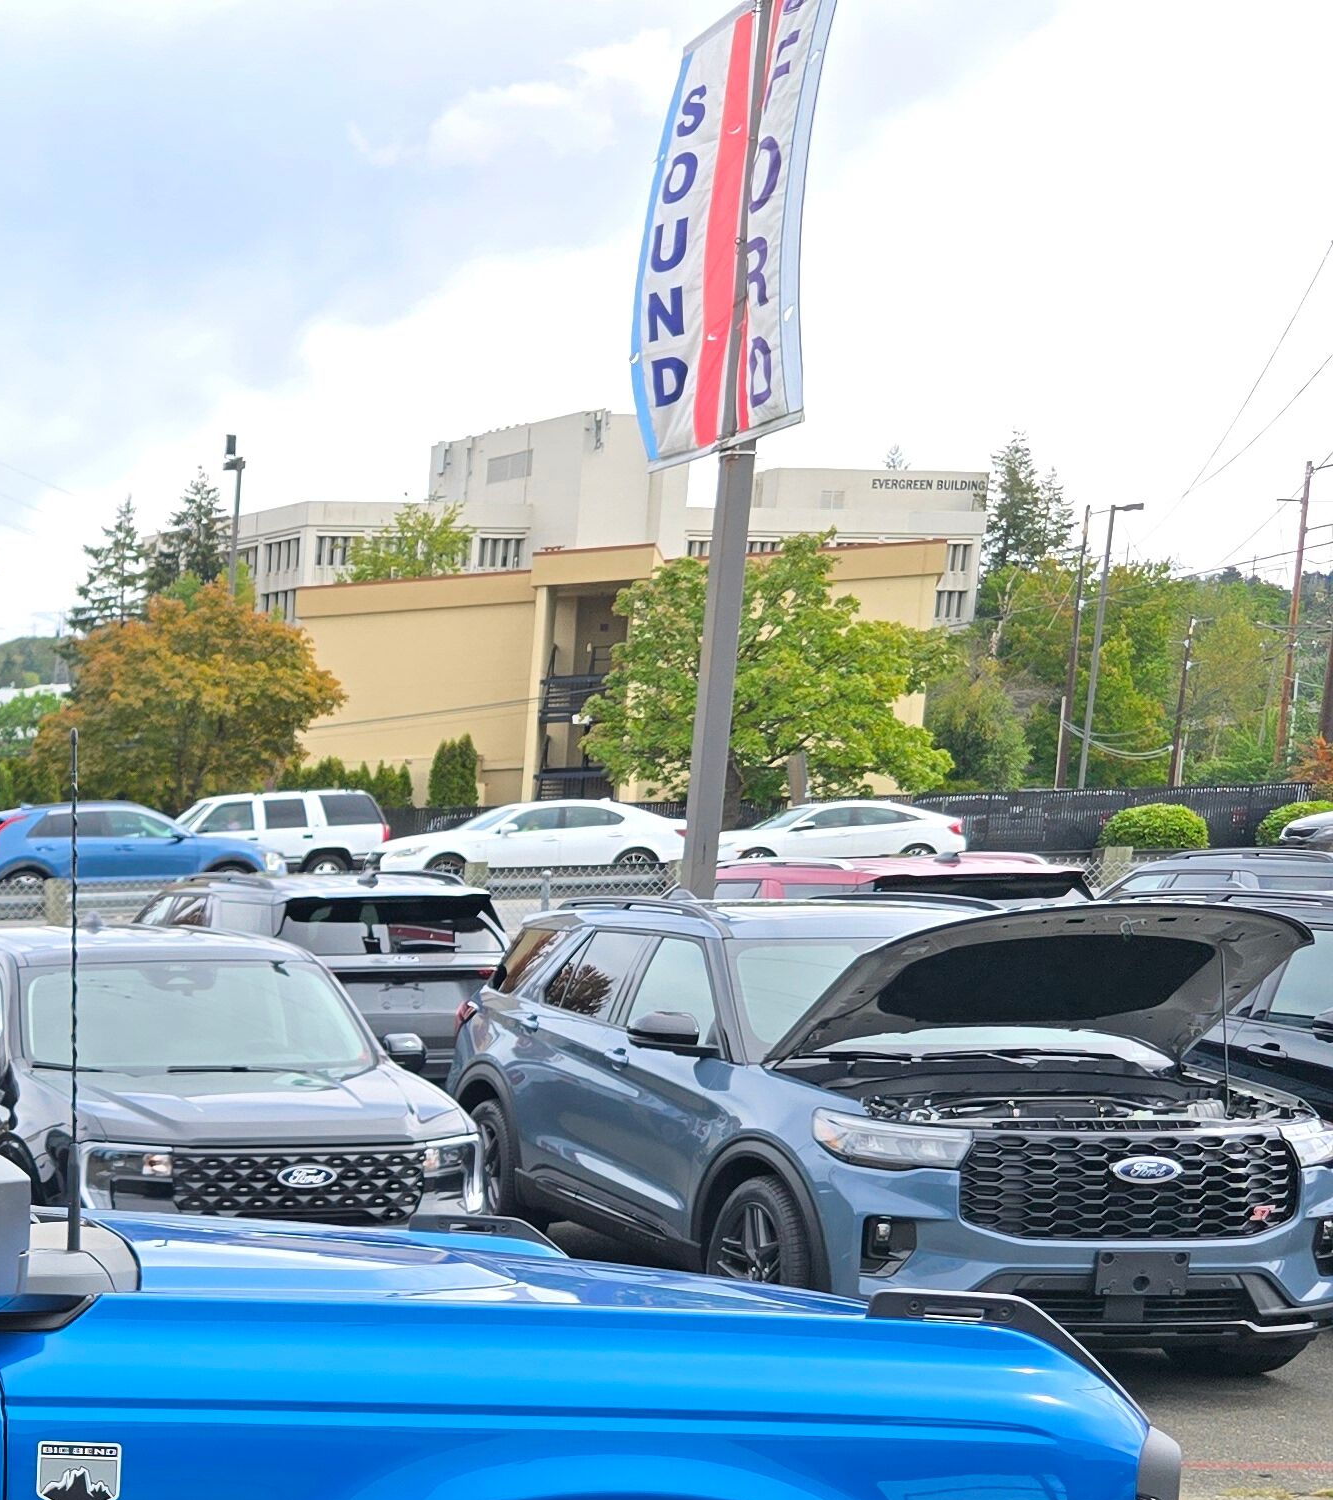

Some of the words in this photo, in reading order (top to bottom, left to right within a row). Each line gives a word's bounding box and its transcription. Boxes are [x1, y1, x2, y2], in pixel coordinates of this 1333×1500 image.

[648, 84, 707, 408] SOUND
[872, 478, 933, 490] EVERGREEN
[936, 479, 986, 491] BUILDING
[286, 1167, 328, 1185] Ford
[1128, 1161, 1169, 1179] Ford
[42, 1446, 70, 1454] BIG
[72, 1447, 117, 1456] BEND
